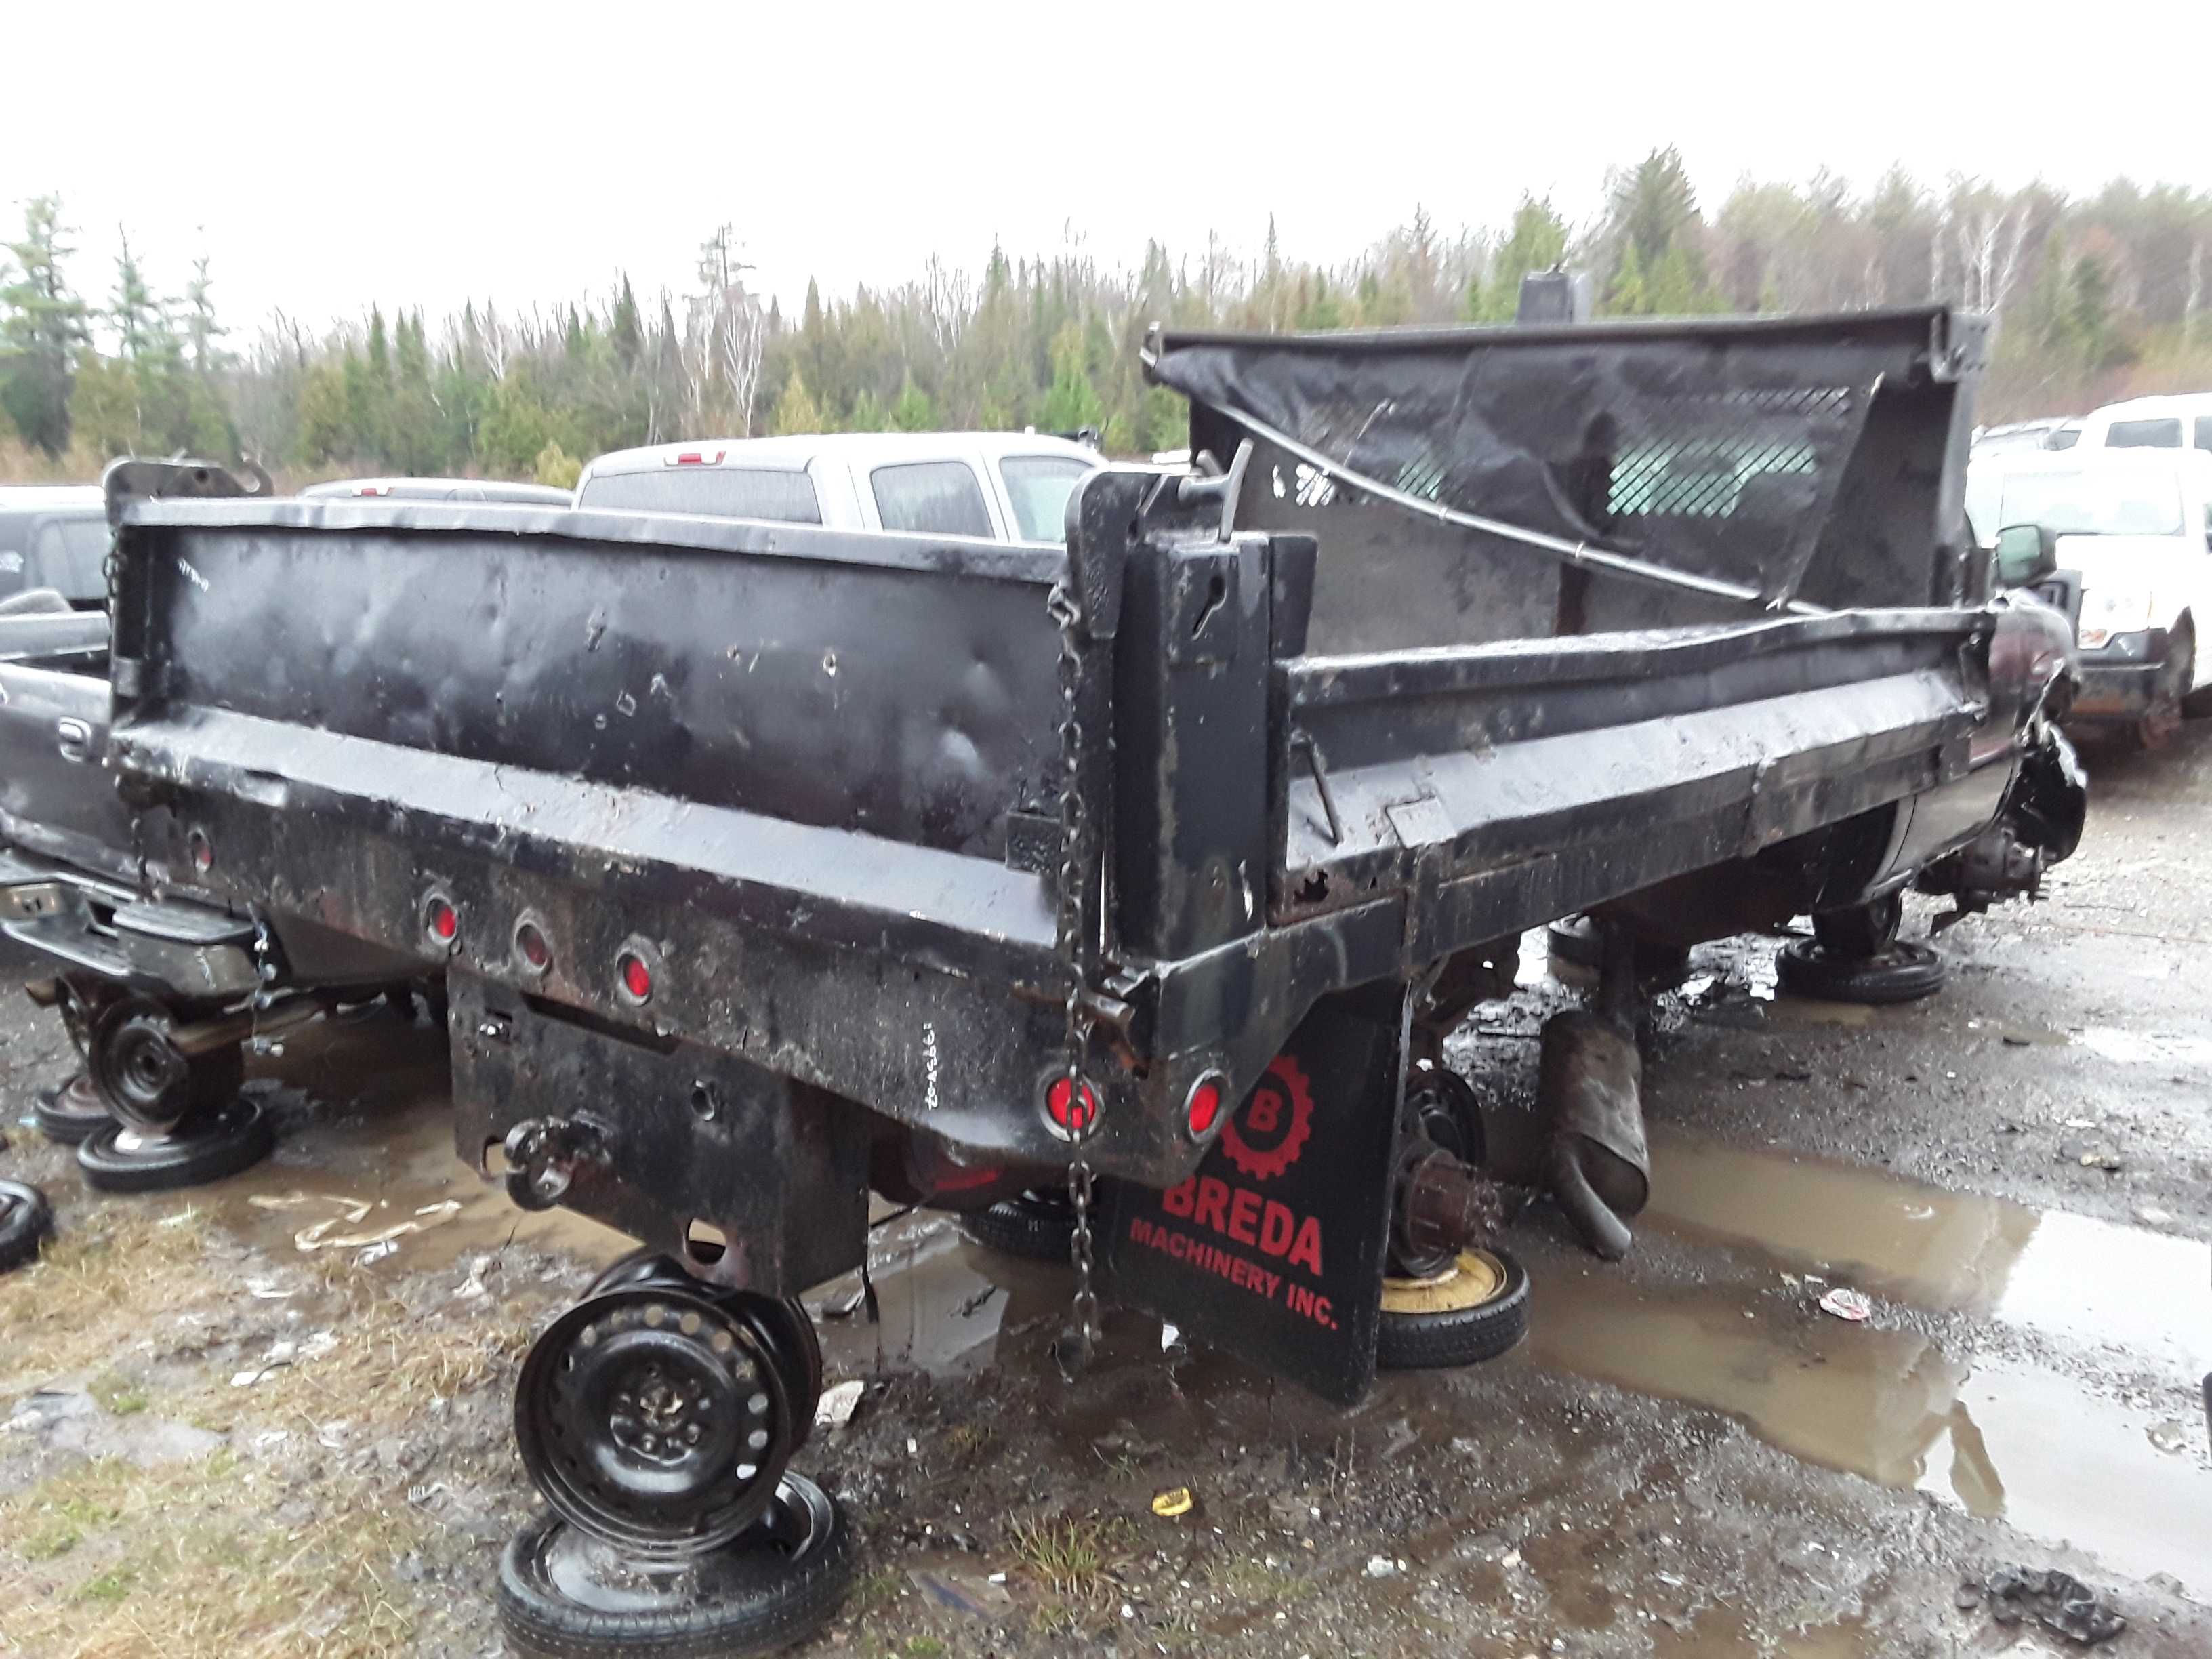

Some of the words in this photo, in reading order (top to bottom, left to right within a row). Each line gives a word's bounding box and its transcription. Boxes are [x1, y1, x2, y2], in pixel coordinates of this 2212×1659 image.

[1246, 1088, 1282, 1132] B
[1130, 1217, 1281, 1298] MACHINERY
[1286, 1283, 1339, 1330] INC.
[1162, 1174, 1322, 1276] BREDA
